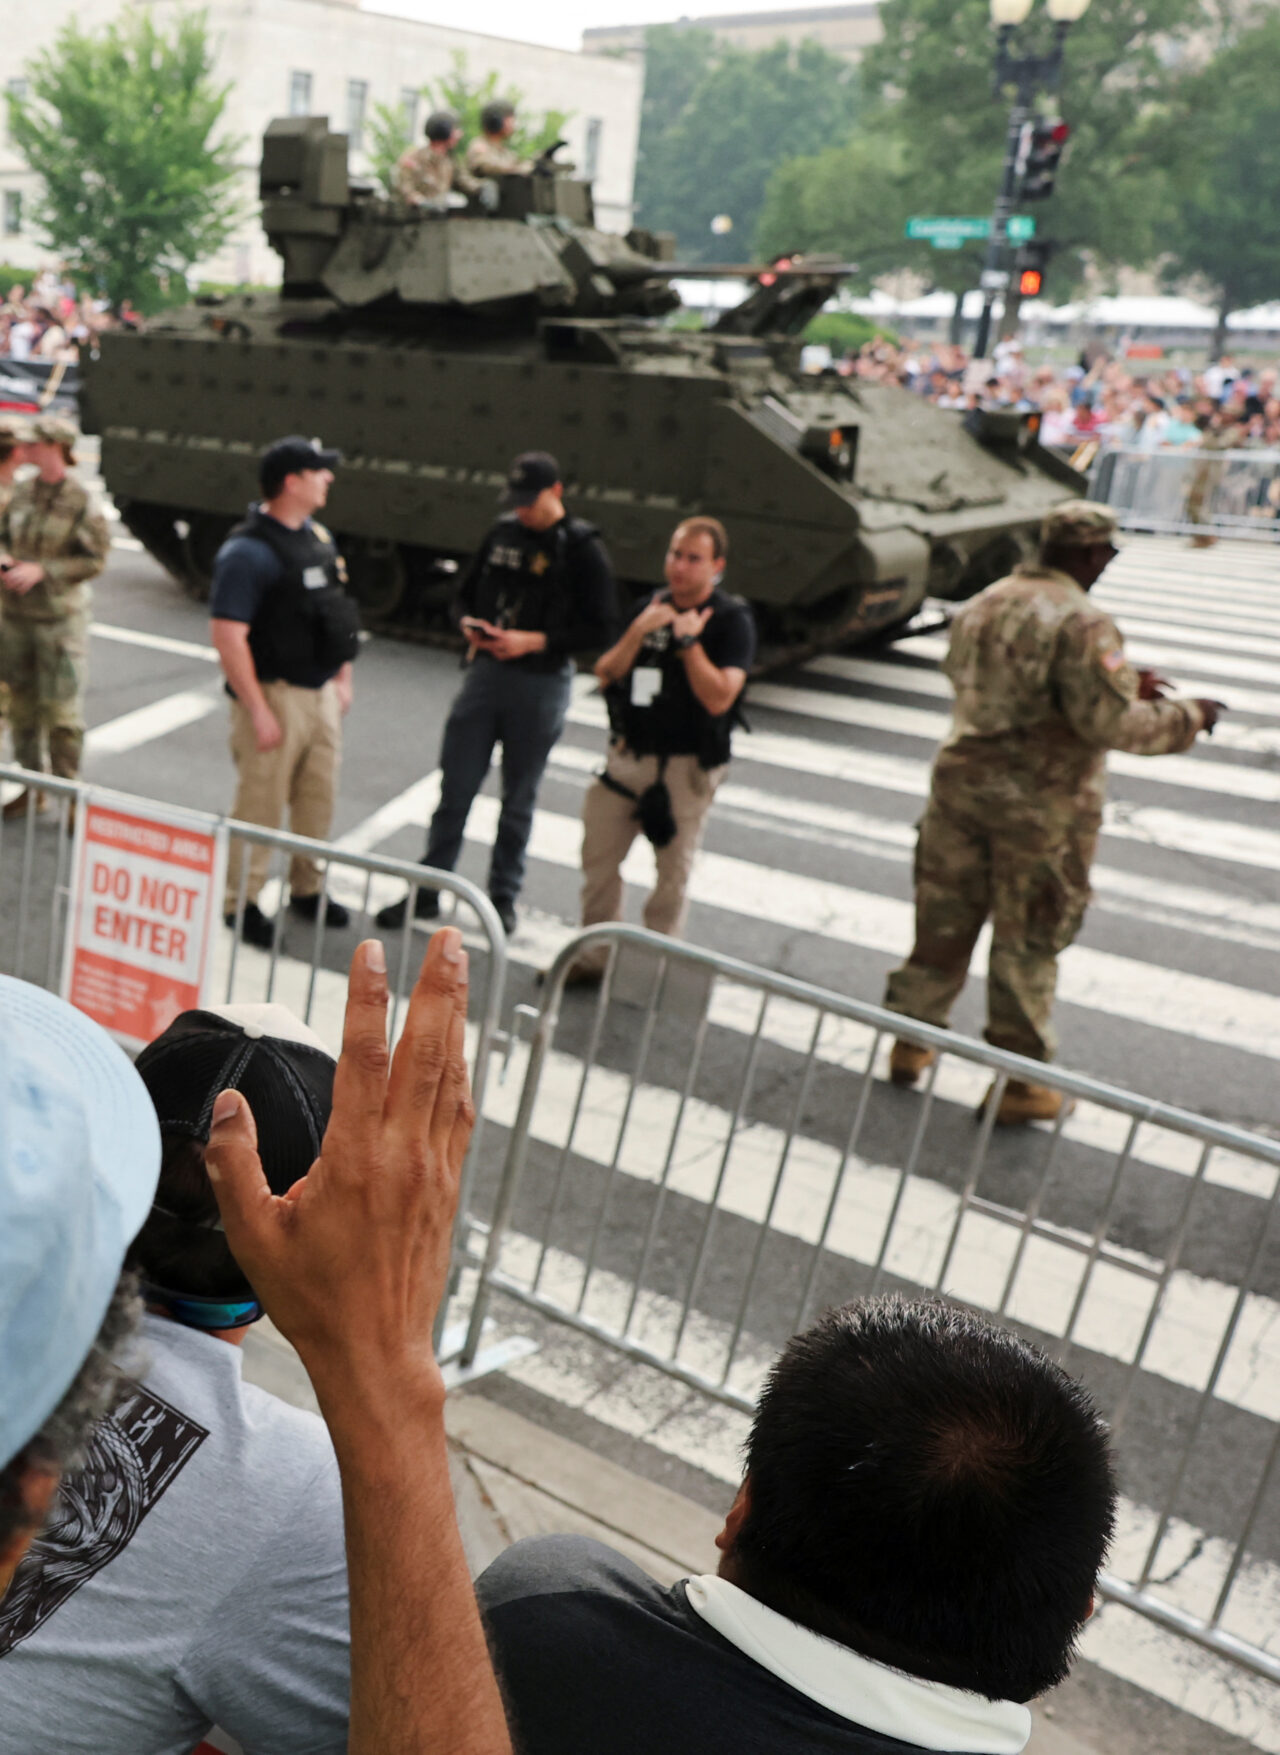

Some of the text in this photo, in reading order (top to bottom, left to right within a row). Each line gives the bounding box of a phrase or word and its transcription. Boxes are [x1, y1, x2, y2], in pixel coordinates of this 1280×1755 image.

[92, 863, 199, 921] DO NOT
[93, 905, 187, 964] ENTER
